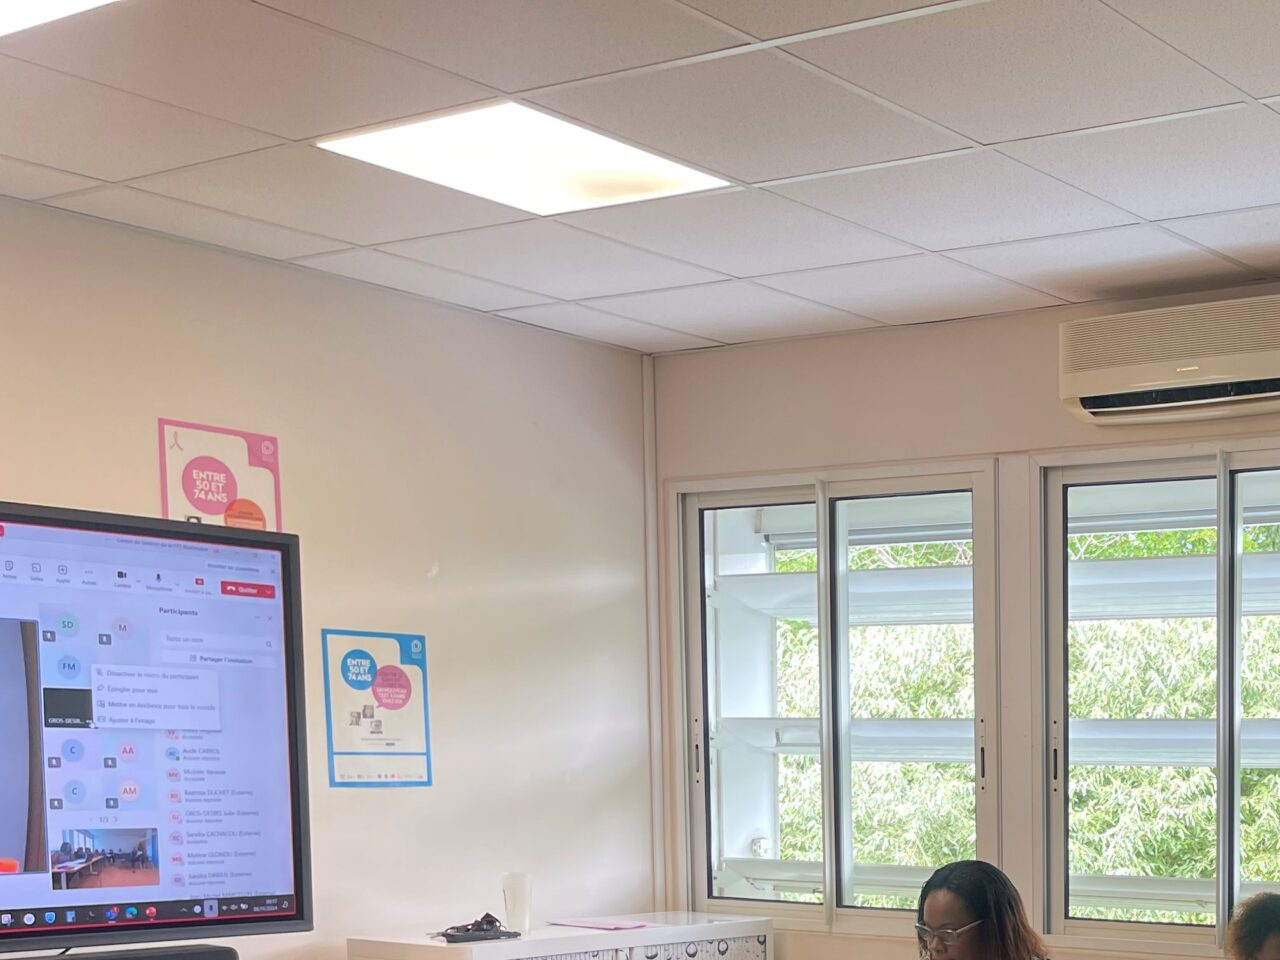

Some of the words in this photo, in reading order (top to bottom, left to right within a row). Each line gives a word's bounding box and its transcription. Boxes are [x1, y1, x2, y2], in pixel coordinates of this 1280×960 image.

[192, 470, 226, 483] ENTRE
[196, 480, 209, 491] 50
[211, 482, 224, 492] ET
[193, 489, 205, 500] 74
[207, 491, 228, 503] ANS
[159, 607, 198, 616] Participants
[62, 621, 74, 629] SD
[118, 624, 127, 632] M
[347, 658, 371, 667] ENTRE
[62, 663, 76, 671] FM
[358, 674, 372, 682] ANS
[69, 746, 76, 754] C
[71, 787, 78, 795] C
[122, 787, 137, 795] AM
